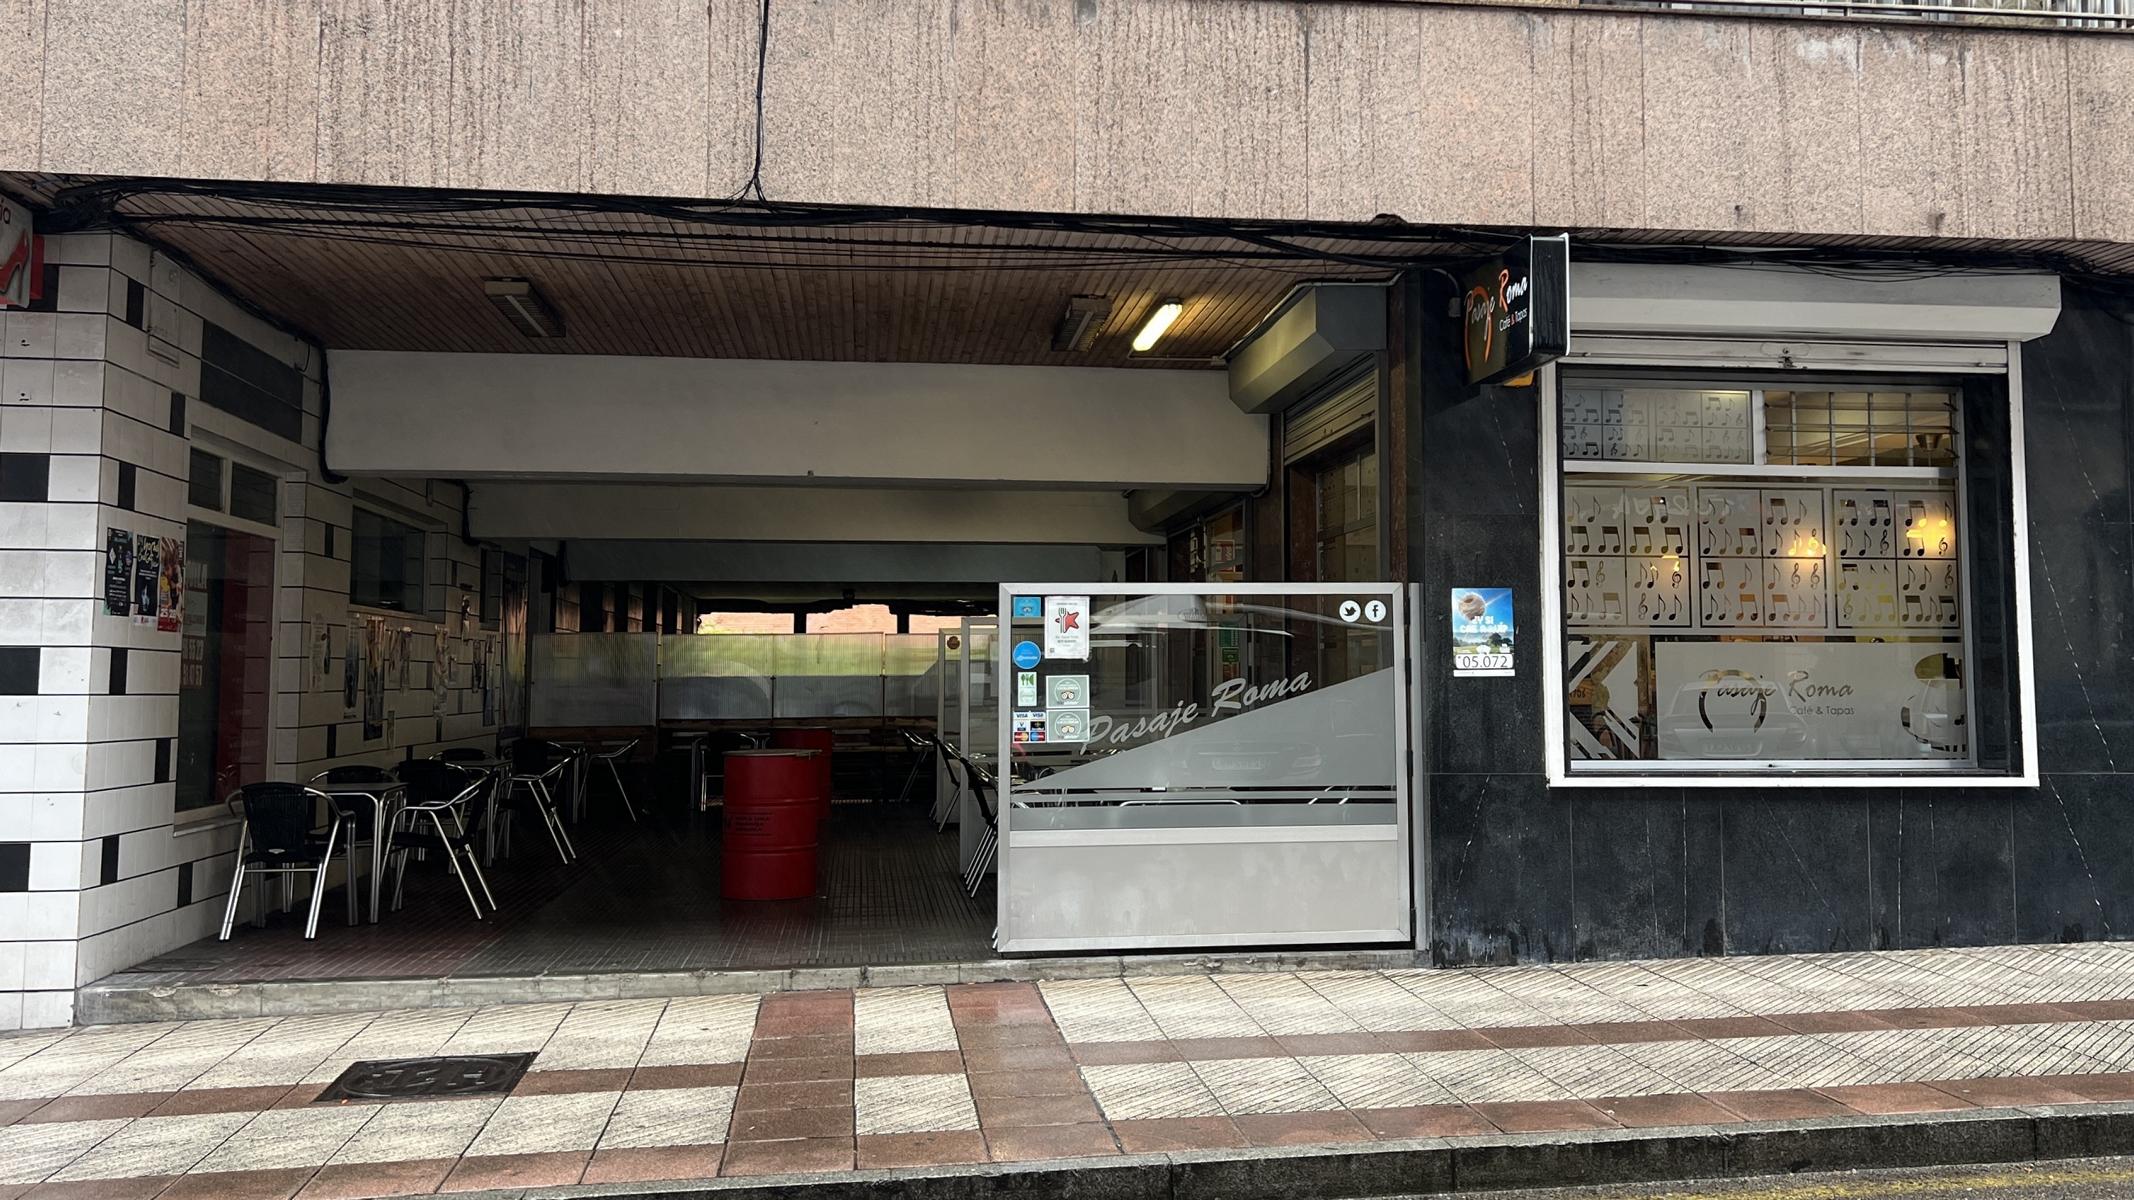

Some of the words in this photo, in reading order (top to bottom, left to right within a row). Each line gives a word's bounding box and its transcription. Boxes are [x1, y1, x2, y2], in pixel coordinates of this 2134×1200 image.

[1499, 268, 1528, 312] Roma
[1515, 308, 1528, 324] Tapas
[1463, 655, 1508, 668] 05.072
[1787, 670, 1854, 703] Roma
[1080, 700, 1199, 755] Pasaje
[1211, 671, 1313, 718] Roma
[1815, 706, 1824, 716] &
[1826, 706, 1855, 718] Tapas
